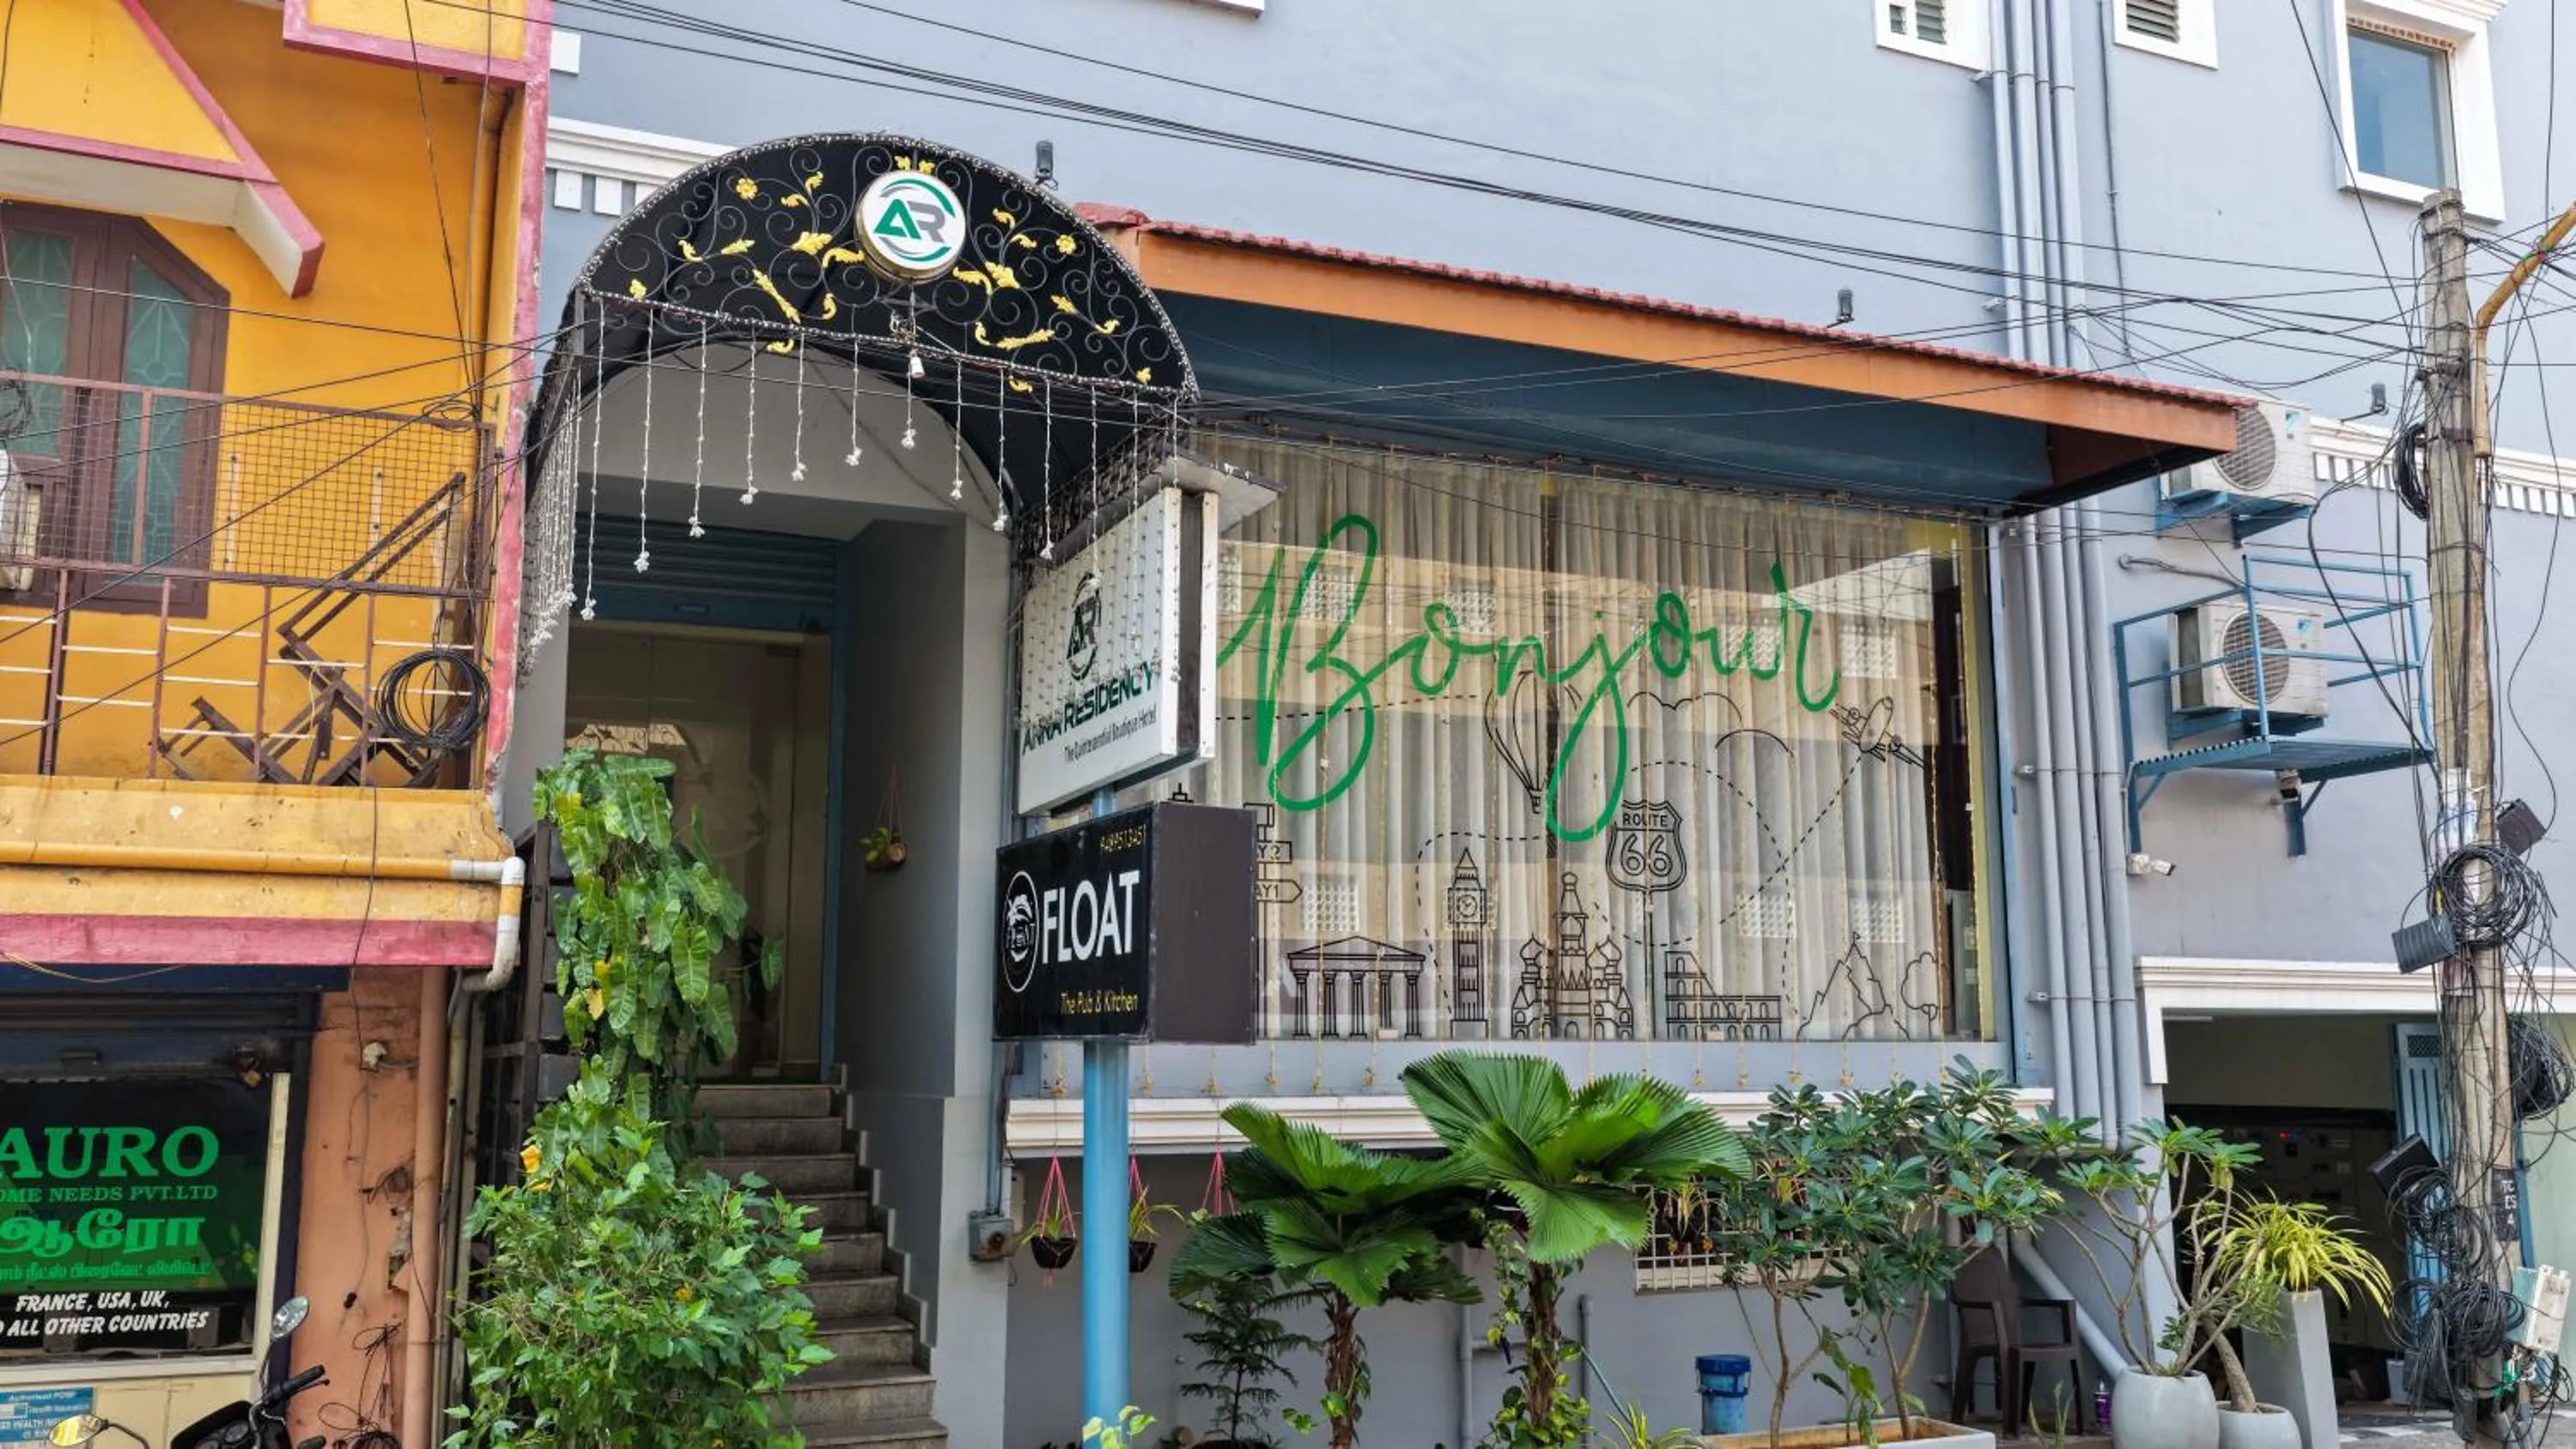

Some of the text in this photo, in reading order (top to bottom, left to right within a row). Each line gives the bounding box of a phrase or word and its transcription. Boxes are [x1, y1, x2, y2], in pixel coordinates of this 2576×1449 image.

[873, 198, 946, 244] AR
[1064, 661, 1153, 732] RESIDENCY
[1216, 513, 1839, 843] Bonjour
[1622, 813, 1668, 828] ROUTE
[1620, 833, 1674, 877] 66
[1042, 870, 1140, 964] FLOAT
[1060, 991, 1075, 1015] The
[1078, 990, 1094, 1013] Pub
[1104, 987, 1138, 1012] Kitchen
[0, 1125, 220, 1179] AURO
[49, 1187, 123, 1202] NEEDS
[15, 1290, 171, 1313] FRANCE, USA, UK,
[7, 1319, 39, 1337] ALL
[45, 1316, 106, 1335] OTHER
[108, 1312, 210, 1333] COUNTRIES
